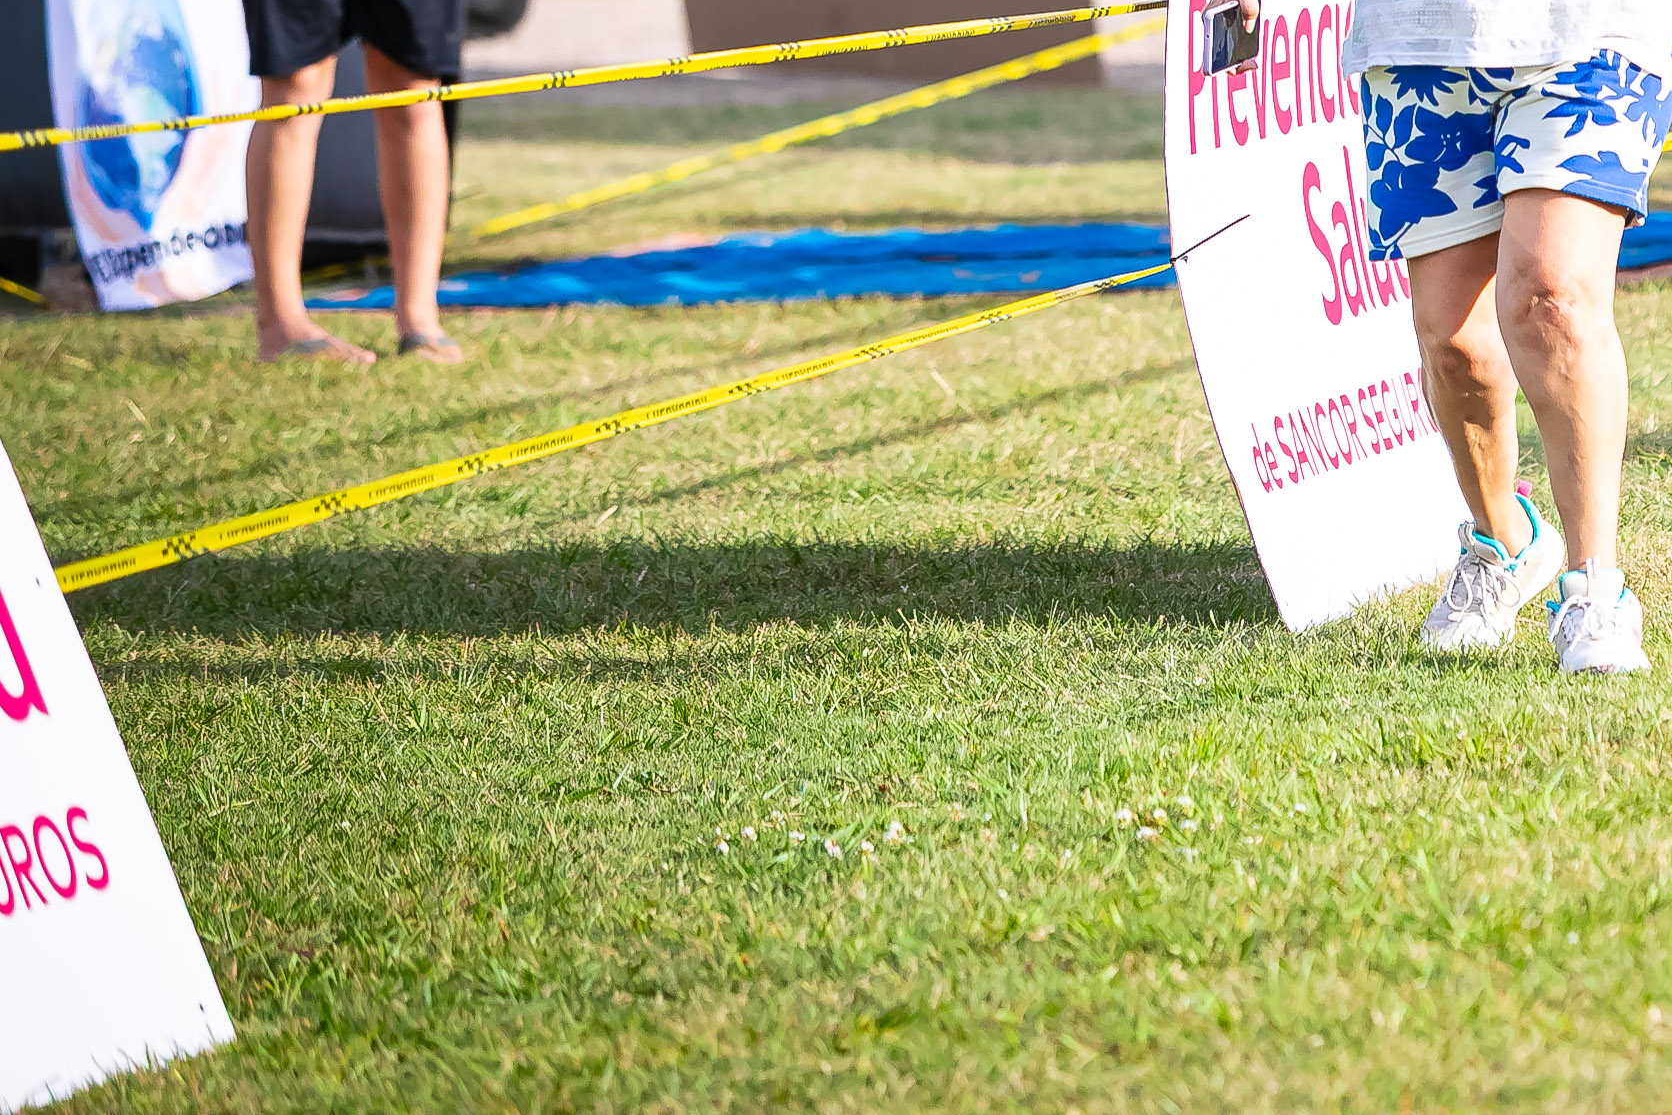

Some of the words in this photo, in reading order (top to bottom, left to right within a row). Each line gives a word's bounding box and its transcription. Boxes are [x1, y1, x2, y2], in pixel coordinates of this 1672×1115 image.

[1302, 145, 1412, 326] Salu
[1250, 422, 1284, 494] de
[1274, 394, 1368, 485] SANCOR
[1358, 366, 1440, 455] SEGUR
